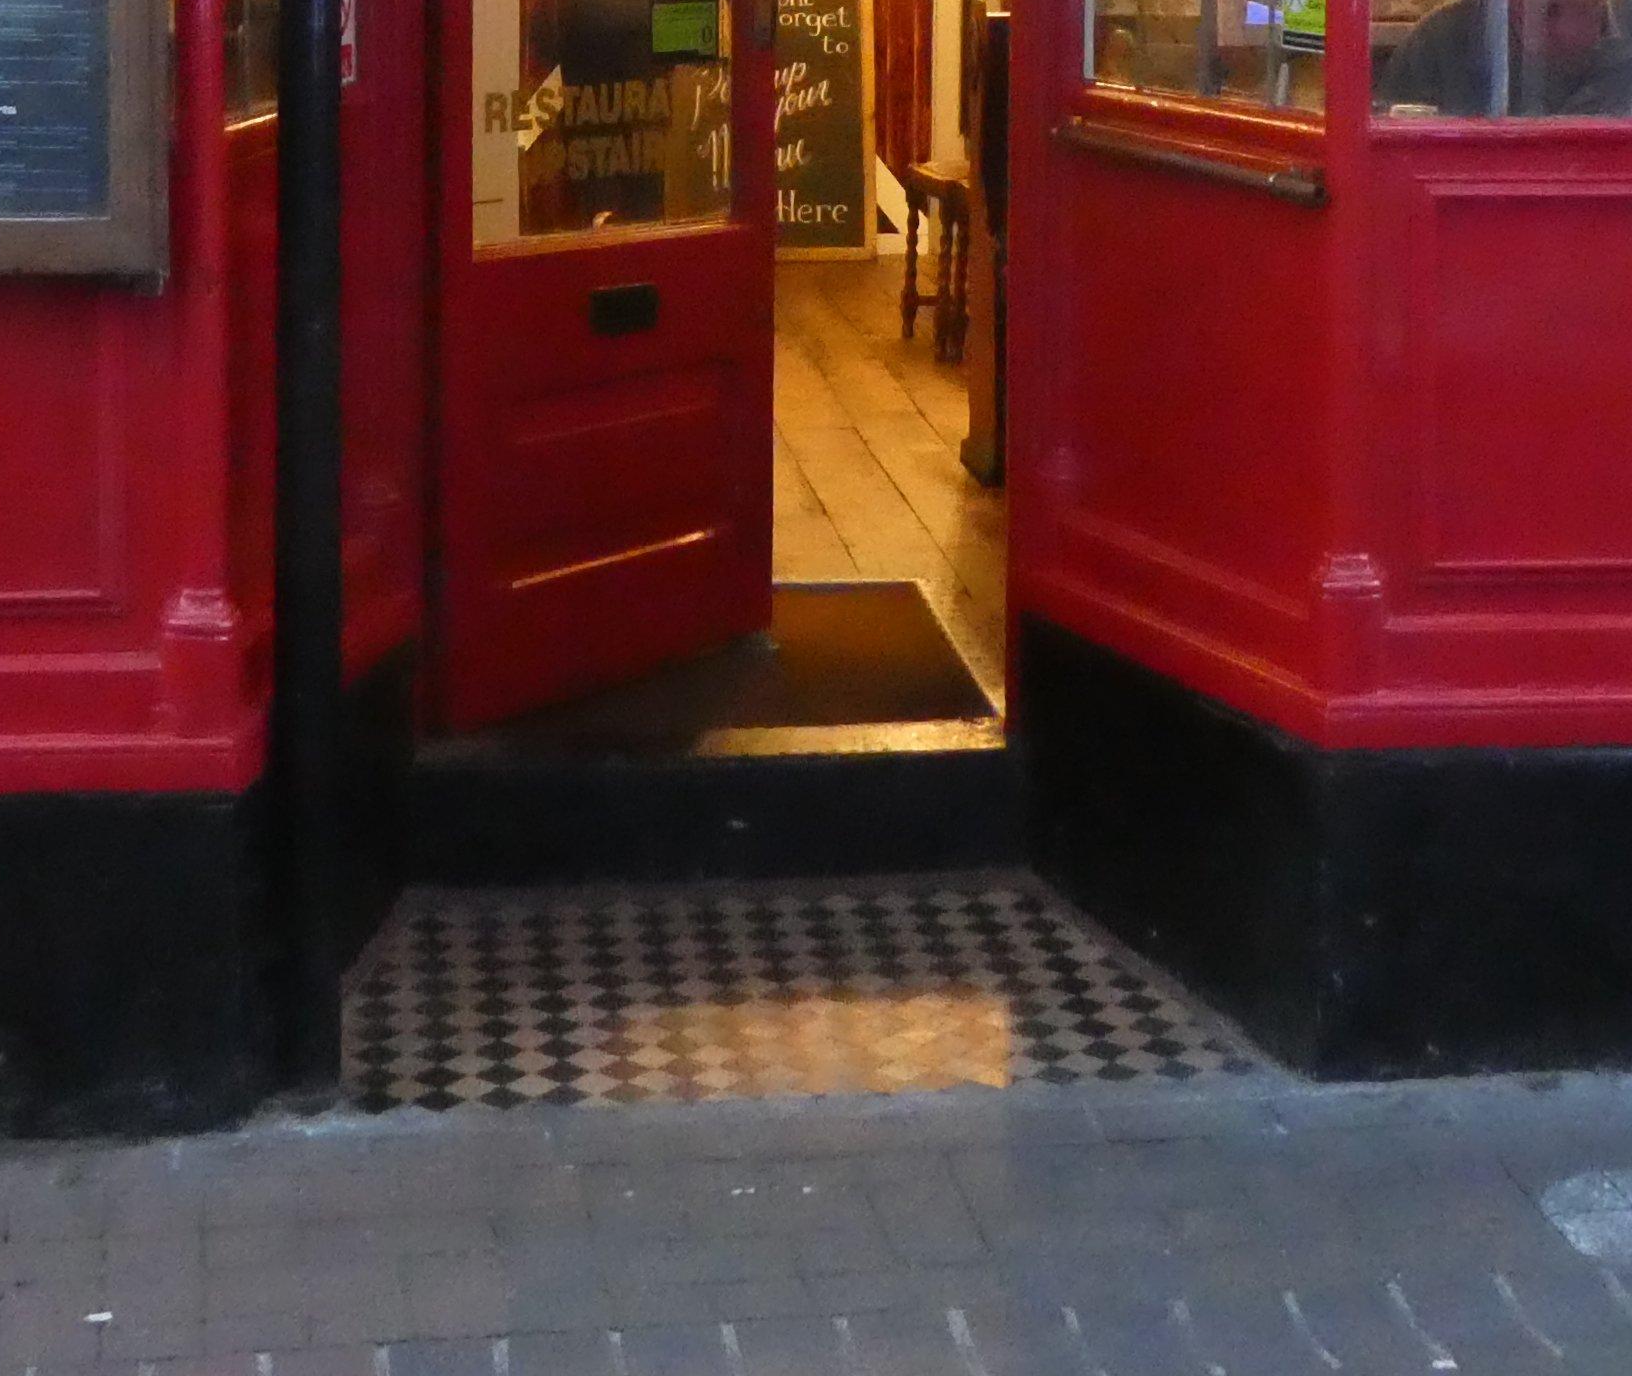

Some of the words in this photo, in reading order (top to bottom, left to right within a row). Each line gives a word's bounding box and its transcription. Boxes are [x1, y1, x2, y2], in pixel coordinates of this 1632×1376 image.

[778, 6, 852, 37] orget
[821, 35, 850, 55] to
[776, 188, 850, 225] Here
